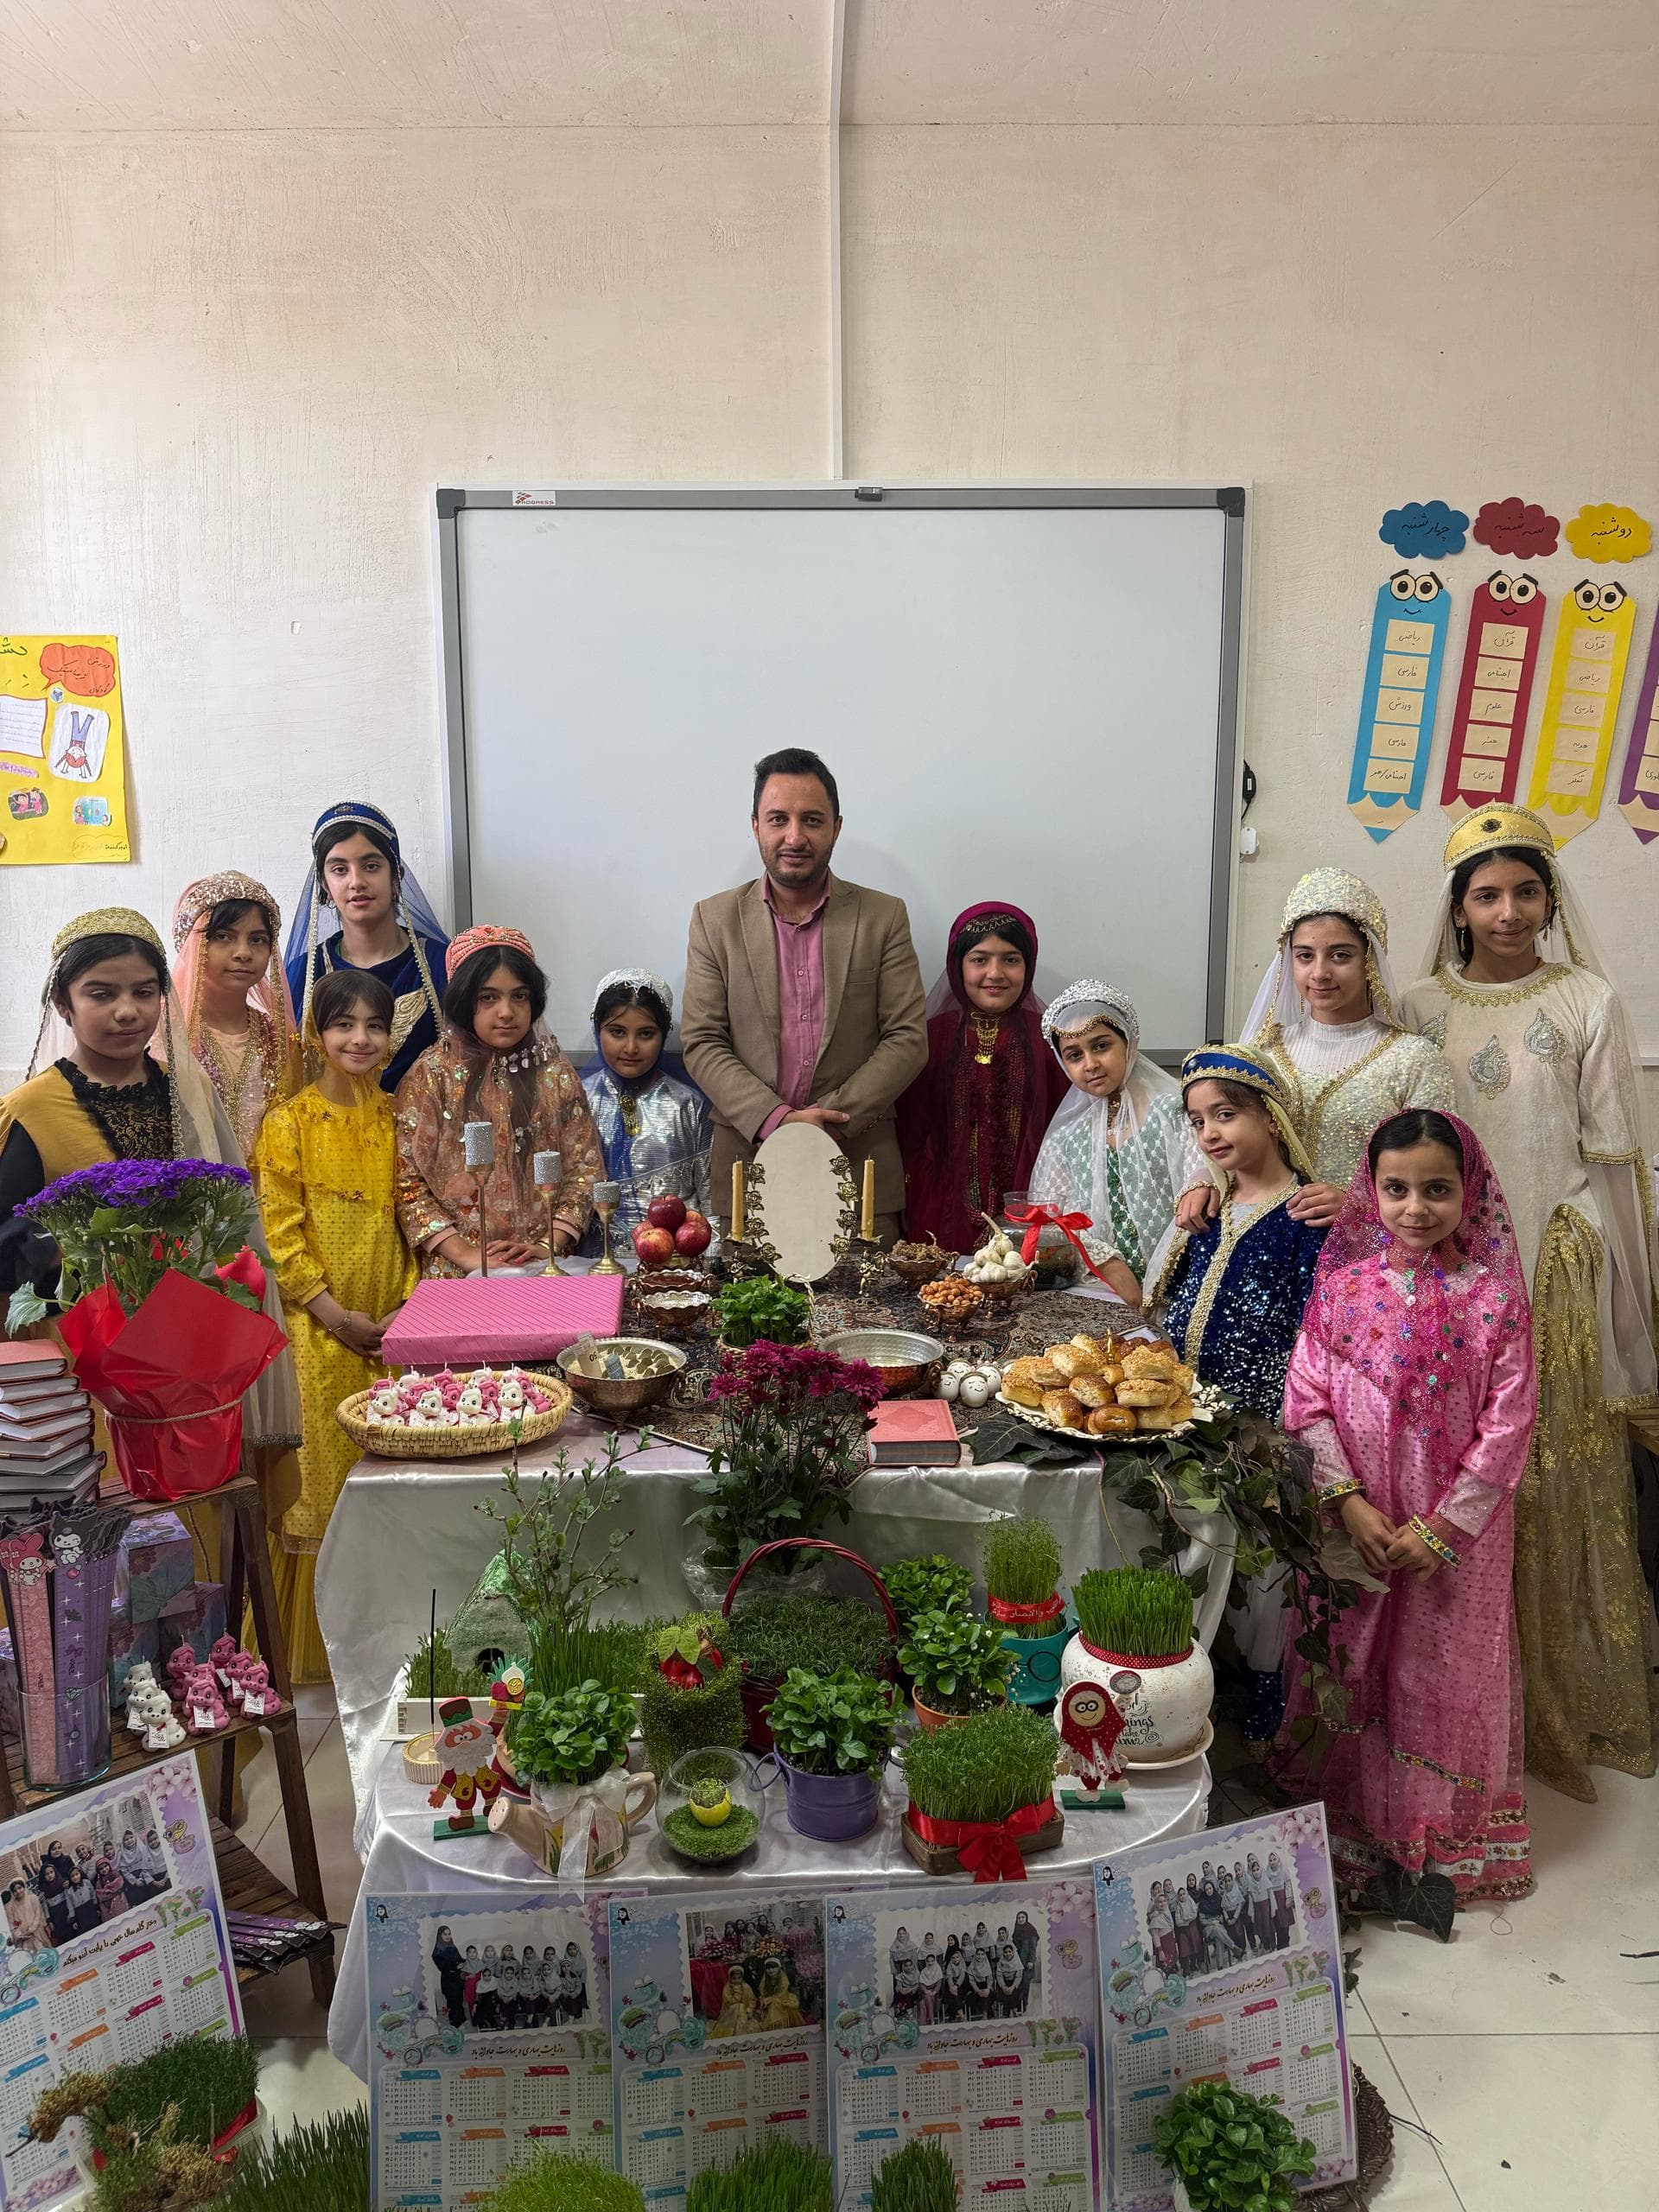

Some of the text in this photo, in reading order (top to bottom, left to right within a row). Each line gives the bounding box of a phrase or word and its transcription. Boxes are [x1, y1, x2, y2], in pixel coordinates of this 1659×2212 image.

[1398, 630, 1421, 645] ریاضی
[1493, 630, 1516, 647] قرآن
[1584, 635, 1606, 651] قرآن
[1397, 666, 1418, 677] فارسی
[1579, 671, 1600, 686] ریاضی
[1389, 696, 1411, 711] ورزش
[1484, 702, 1502, 715] علوم
[1573, 704, 1595, 715] فارسی
[1388, 737, 1407, 747] فارسی
[1482, 736, 1497, 746] هنر
[1573, 741, 1588, 753] هدیه
[1473, 770, 1494, 781] فارسی
[1239, 1982, 1255, 1993] بهاری
[1254, 1974, 1275, 1989] روزهایت
[1217, 1987, 1236, 1998] بهارت
[950, 2038, 971, 2050] بهارت
[976, 2037, 994, 2048] بهاری
[993, 2032, 1018, 2047] روزهایت
[496, 2046, 518, 2058] بهارت
[522, 2046, 541, 2057] بهاری
[540, 2043, 567, 2056] روزهایت
